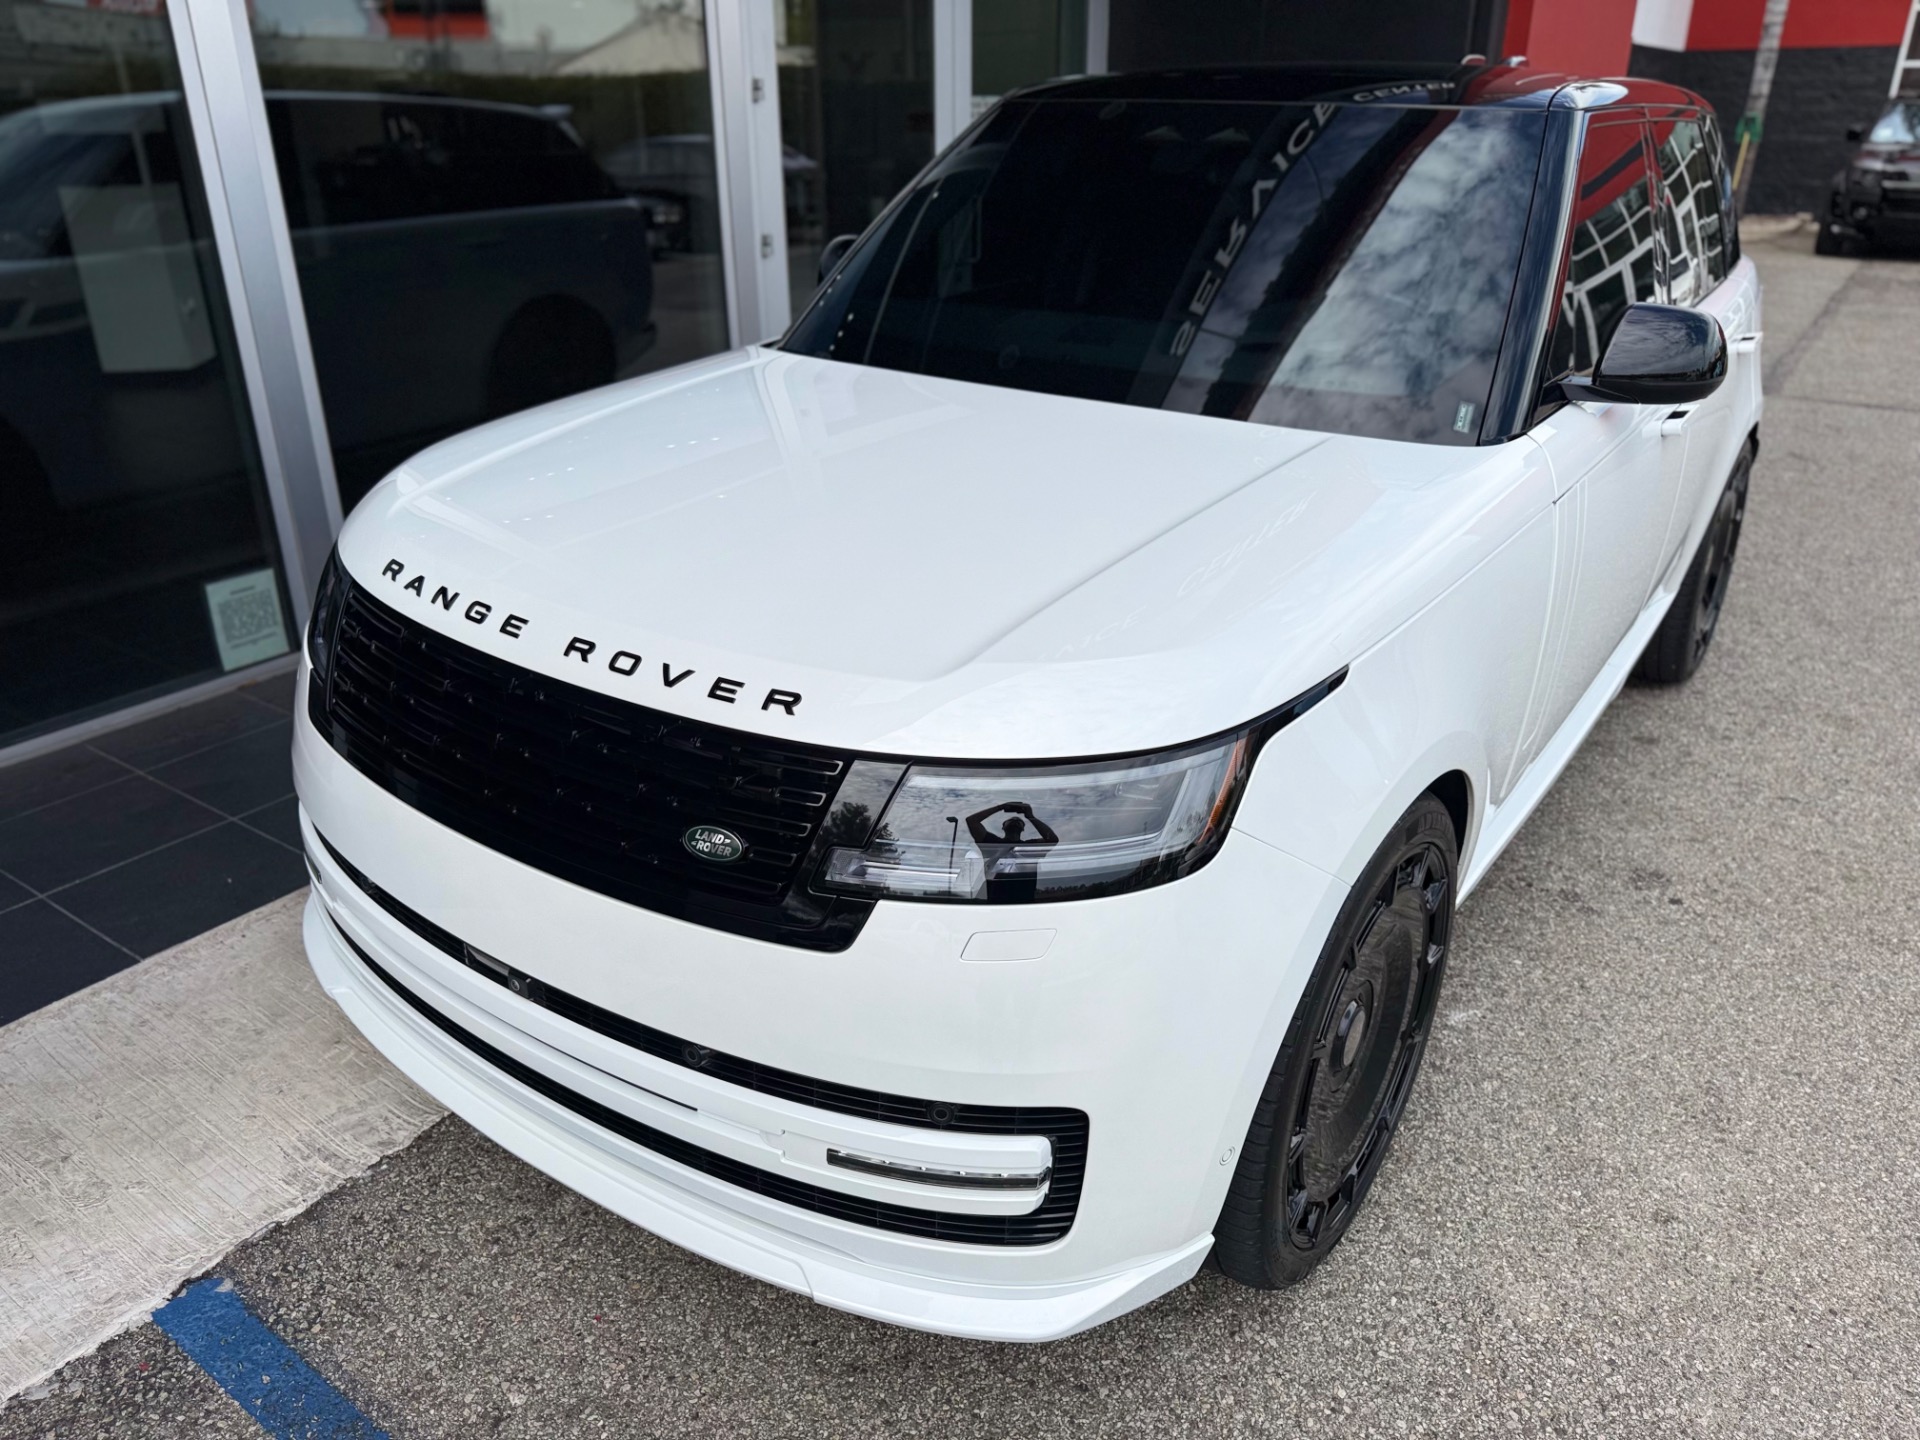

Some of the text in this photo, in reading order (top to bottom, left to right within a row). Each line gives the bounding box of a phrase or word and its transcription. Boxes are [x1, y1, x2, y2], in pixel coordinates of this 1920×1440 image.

[381, 558, 802, 716] RANGE ROVER
[695, 829, 725, 845] LAND
[696, 840, 732, 857] ROVER
